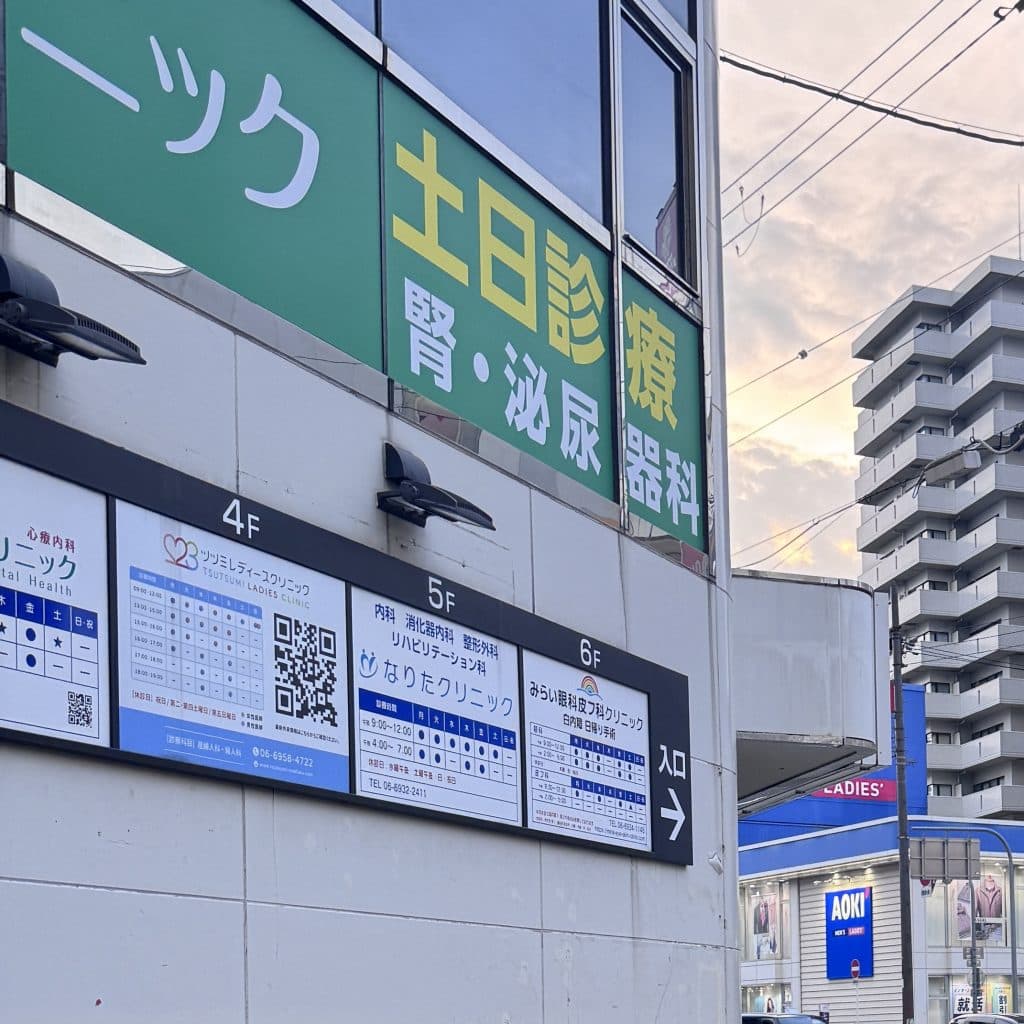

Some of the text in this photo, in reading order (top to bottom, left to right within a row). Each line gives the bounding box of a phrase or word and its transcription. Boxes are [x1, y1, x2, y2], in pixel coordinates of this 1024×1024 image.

[392, 128, 679, 430] 土日診療
[404, 277, 700, 537] 腎・泌尿器科
[222, 498, 260, 539] 4F
[27, 526, 76, 554] 心療内科
[29, 574, 72, 597] Health
[200, 550, 310, 596] ツツミレディースクリニック
[203, 566, 246, 588] TSUTSUMI
[247, 582, 278, 599] LADIES
[281, 593, 311, 609] CLINIC
[25, 601, 35, 614] 金
[52, 609, 63, 621] 土
[427, 575, 455, 613] 5F
[374, 603, 499, 661] 内科 消化器内科 整形外科
[392, 631, 486, 677] リハビリテーション科
[580, 638, 601, 669] 6F
[384, 658, 513, 717] なりたクリニック
[529, 680, 644, 732] みらい眼科皮フ科クリニック
[658, 744, 686, 780] 入口
[369, 777, 382, 790] TEL
[831, 892, 866, 921] AOKI
